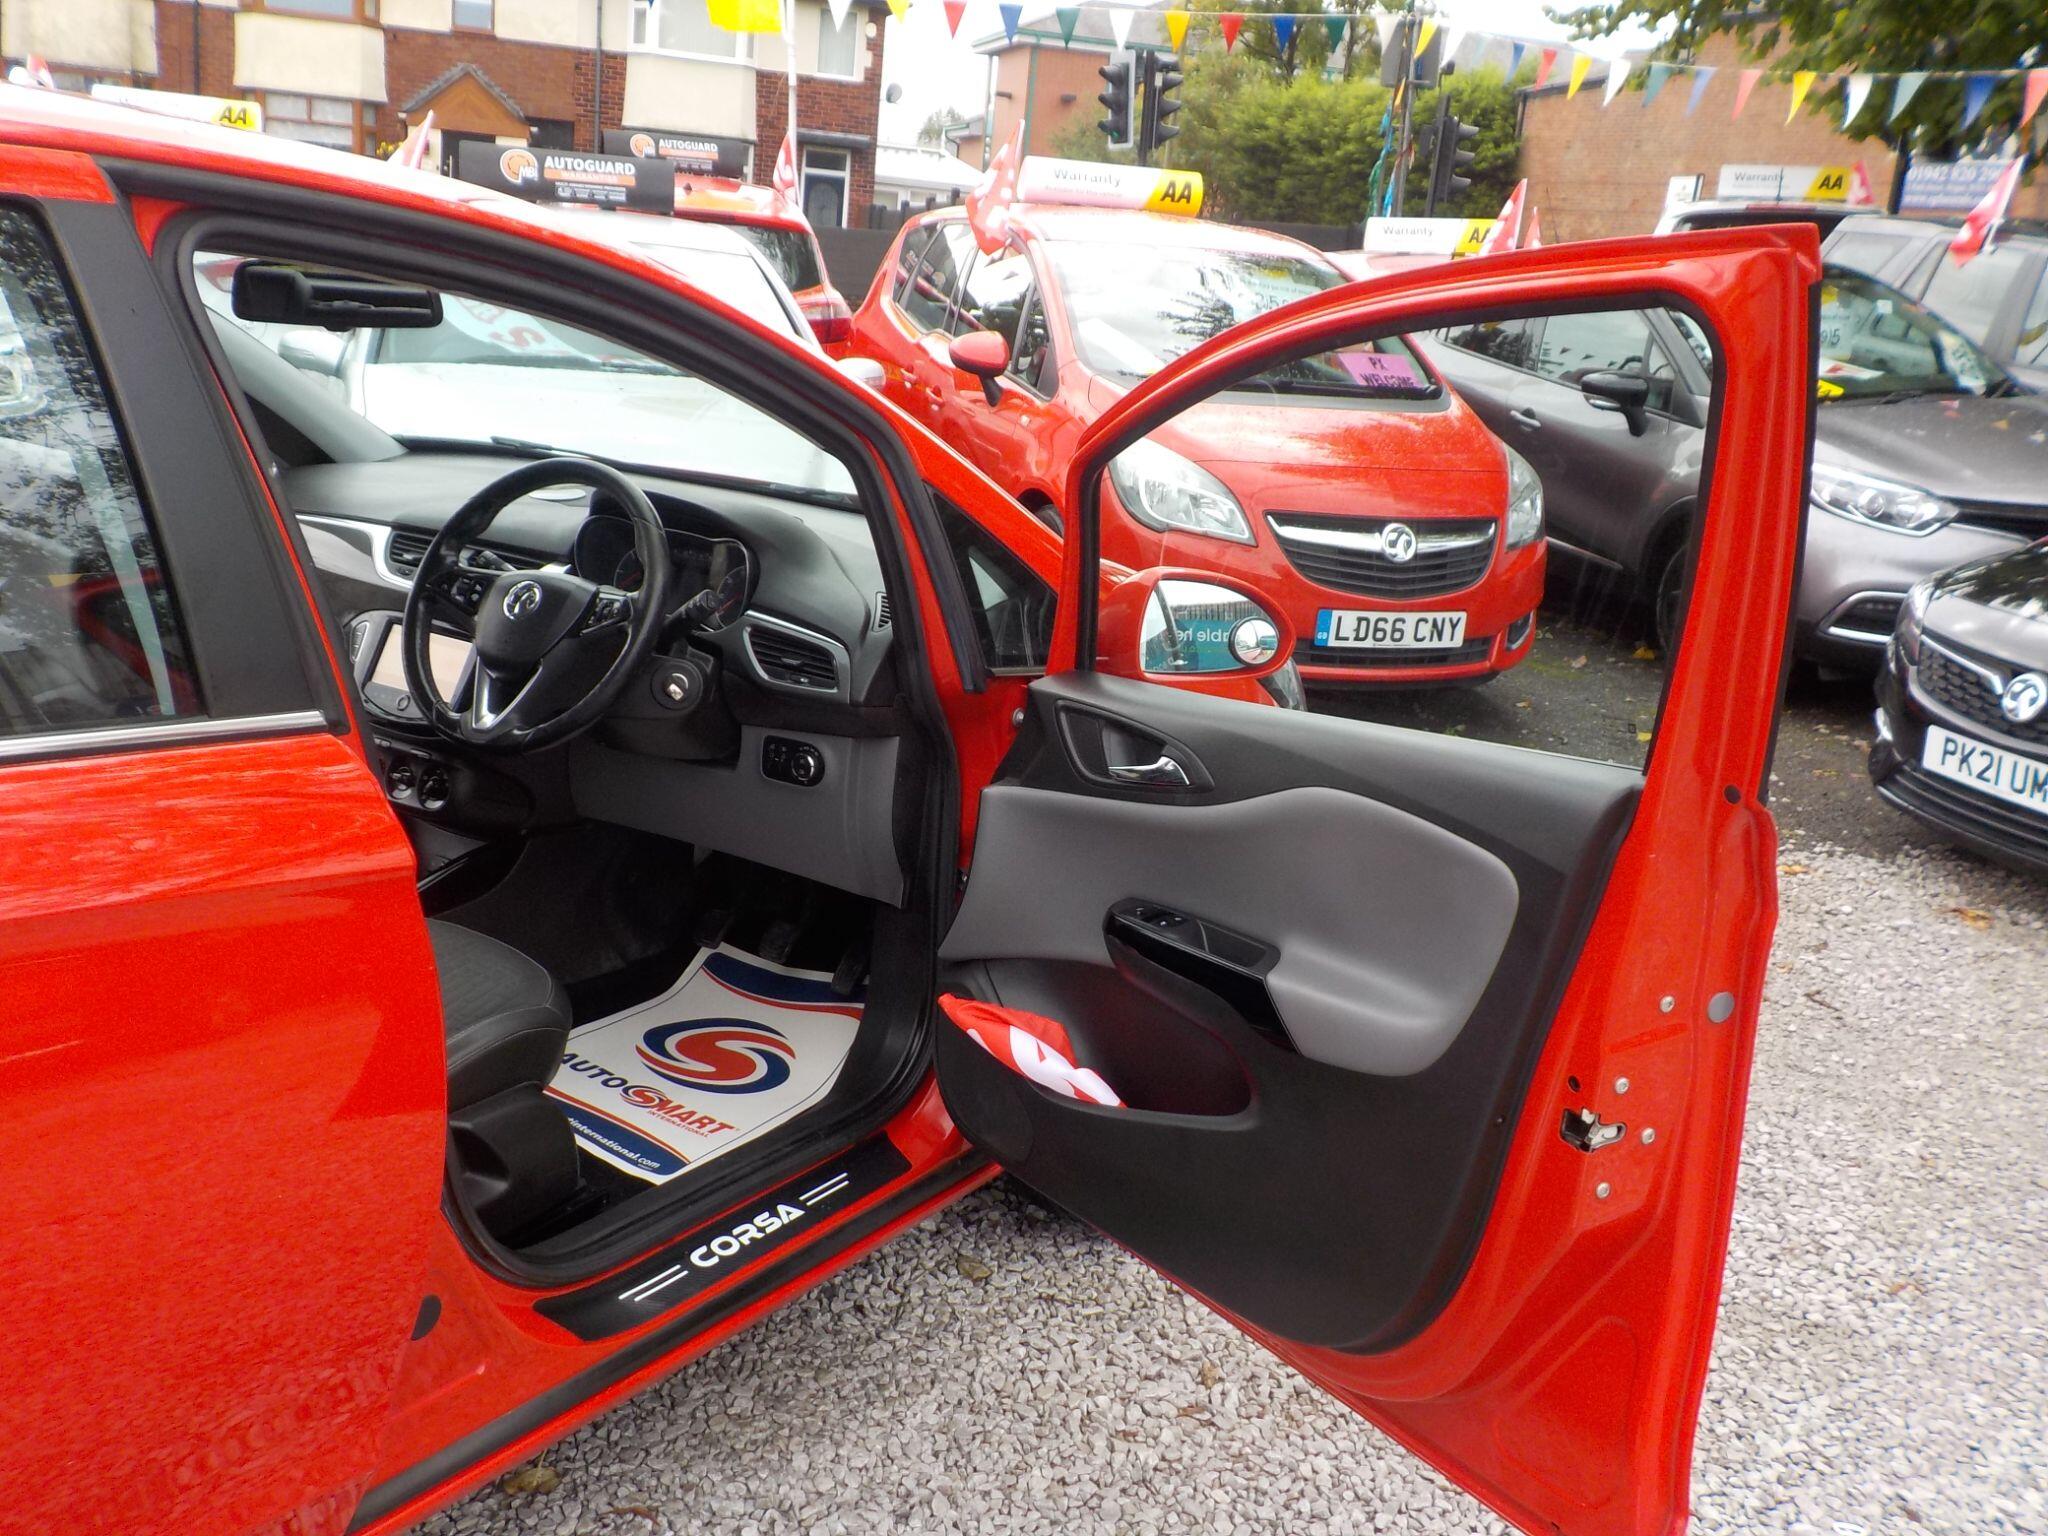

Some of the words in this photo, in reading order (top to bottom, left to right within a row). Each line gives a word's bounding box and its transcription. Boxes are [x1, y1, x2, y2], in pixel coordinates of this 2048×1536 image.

[219, 106, 247, 125] AA
[658, 139, 718, 152] AUTOGUARD
[544, 156, 636, 175] AUTOGUARD
[1054, 168, 1121, 187] Warranty
[1818, 174, 1844, 190] AA
[1160, 180, 1192, 204] AA
[1383, 226, 1433, 237] Warranty
[1334, 616, 1406, 642] LD66
[1413, 617, 1461, 642] CNY
[1941, 736, 2002, 786] PK21
[647, 1110, 709, 1138] INTERNATIONAL
[690, 1204, 806, 1268] CORSA
